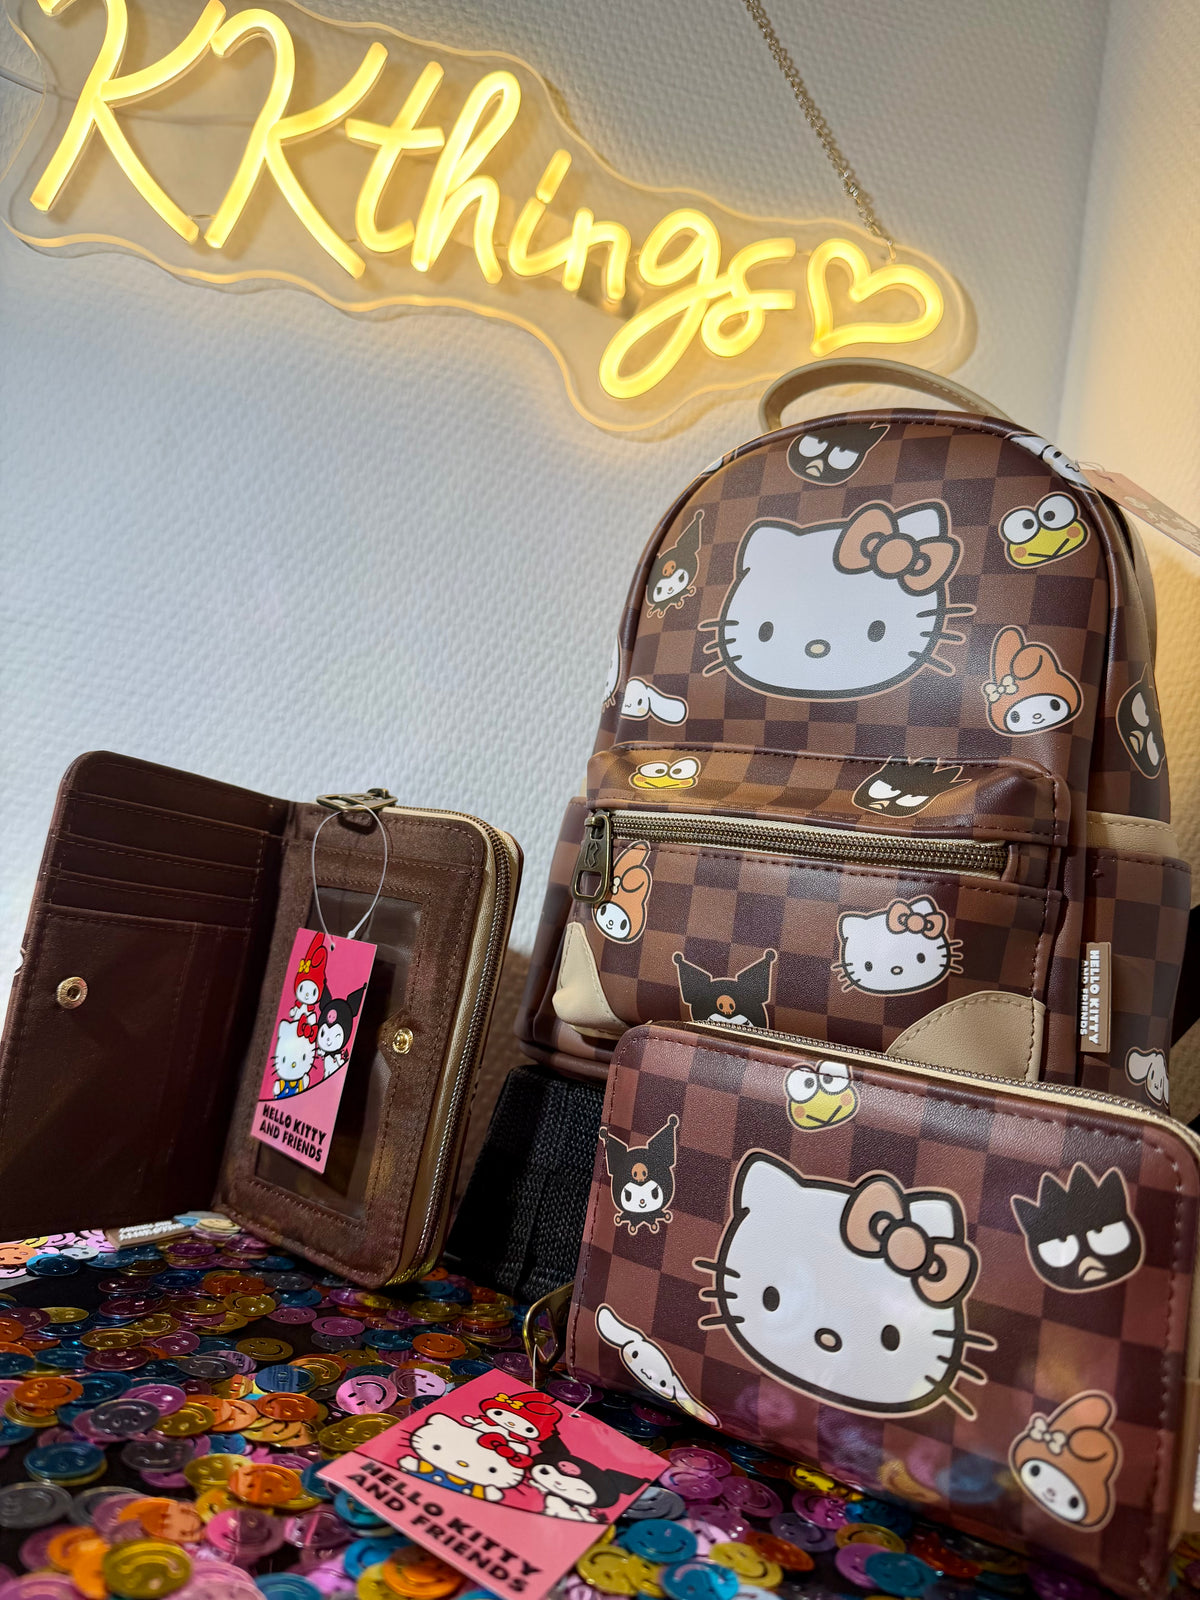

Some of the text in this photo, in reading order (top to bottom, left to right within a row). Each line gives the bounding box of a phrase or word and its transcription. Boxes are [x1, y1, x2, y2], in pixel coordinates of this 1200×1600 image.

[1088, 949, 1100, 1045] HELLO KITTY
[259, 1119, 322, 1161] AND FRIENDS
[262, 1103, 327, 1145] HELLO KITTY
[347, 1474, 530, 1593] AND FRIENDS
[360, 1462, 543, 1577] HELLO KITTY
